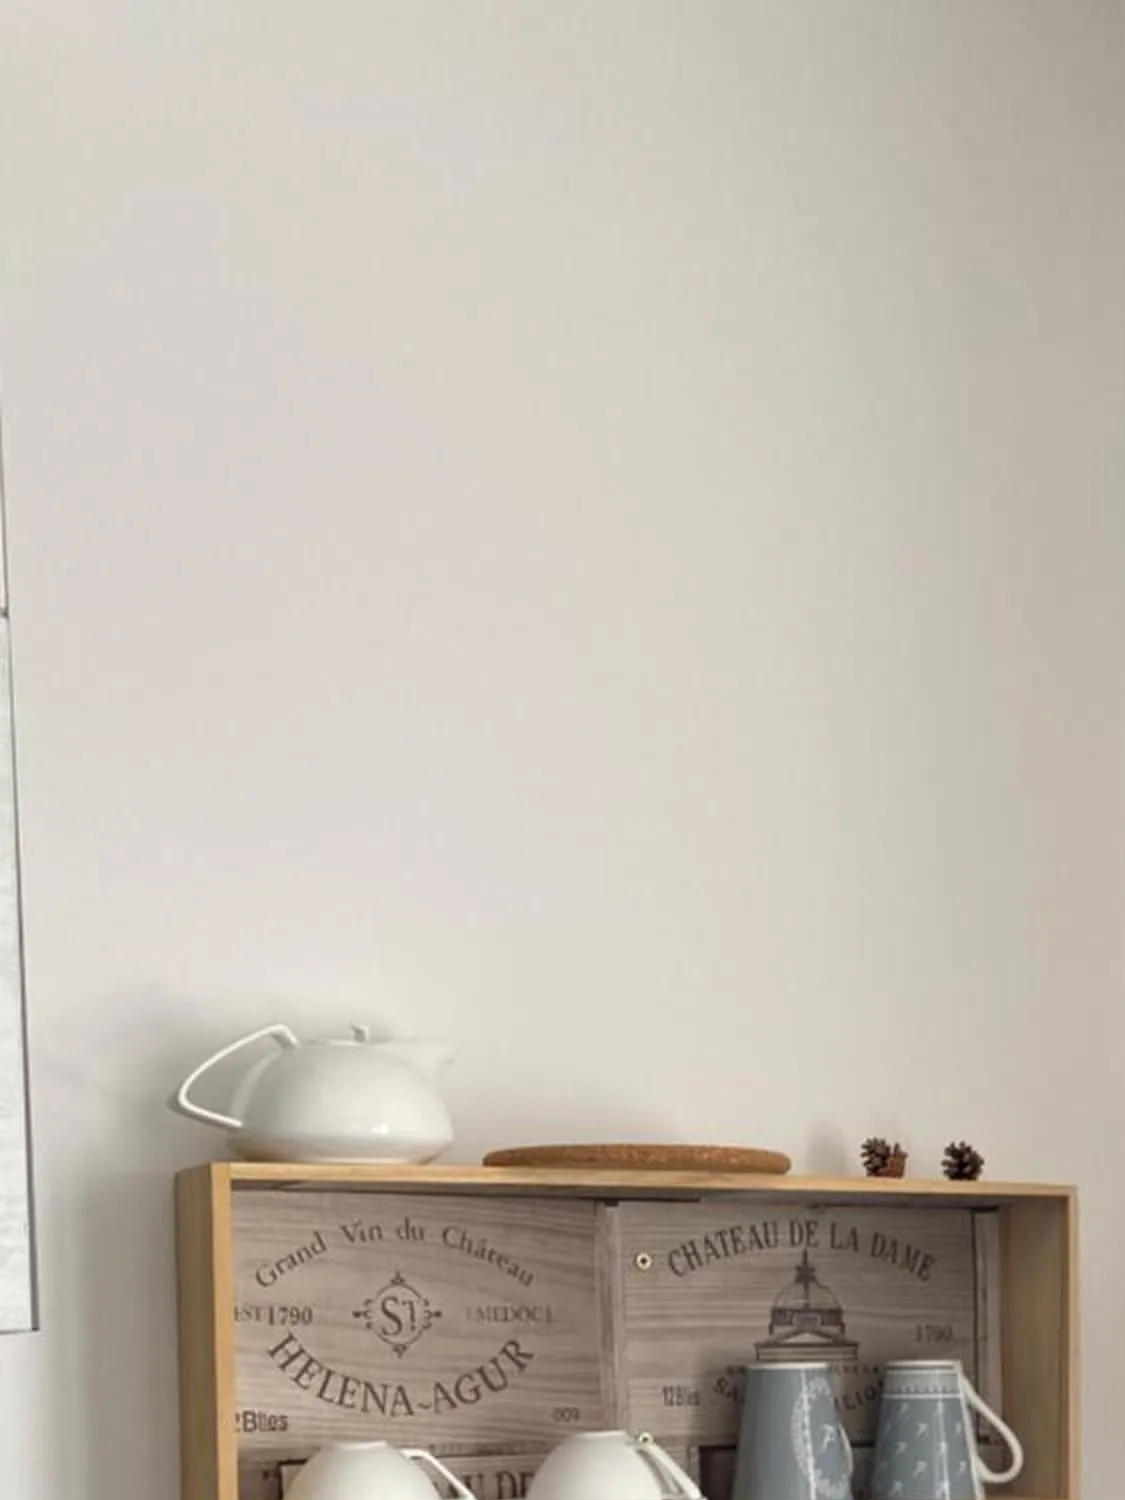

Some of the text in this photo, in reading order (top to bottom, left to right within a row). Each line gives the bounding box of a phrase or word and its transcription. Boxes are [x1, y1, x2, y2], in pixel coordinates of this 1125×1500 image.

[255, 1217, 534, 1288] Grand Vin du Château
[668, 1219, 936, 1281] CHATEAU DE LA DAME
[268, 1305, 313, 1326] 1790
